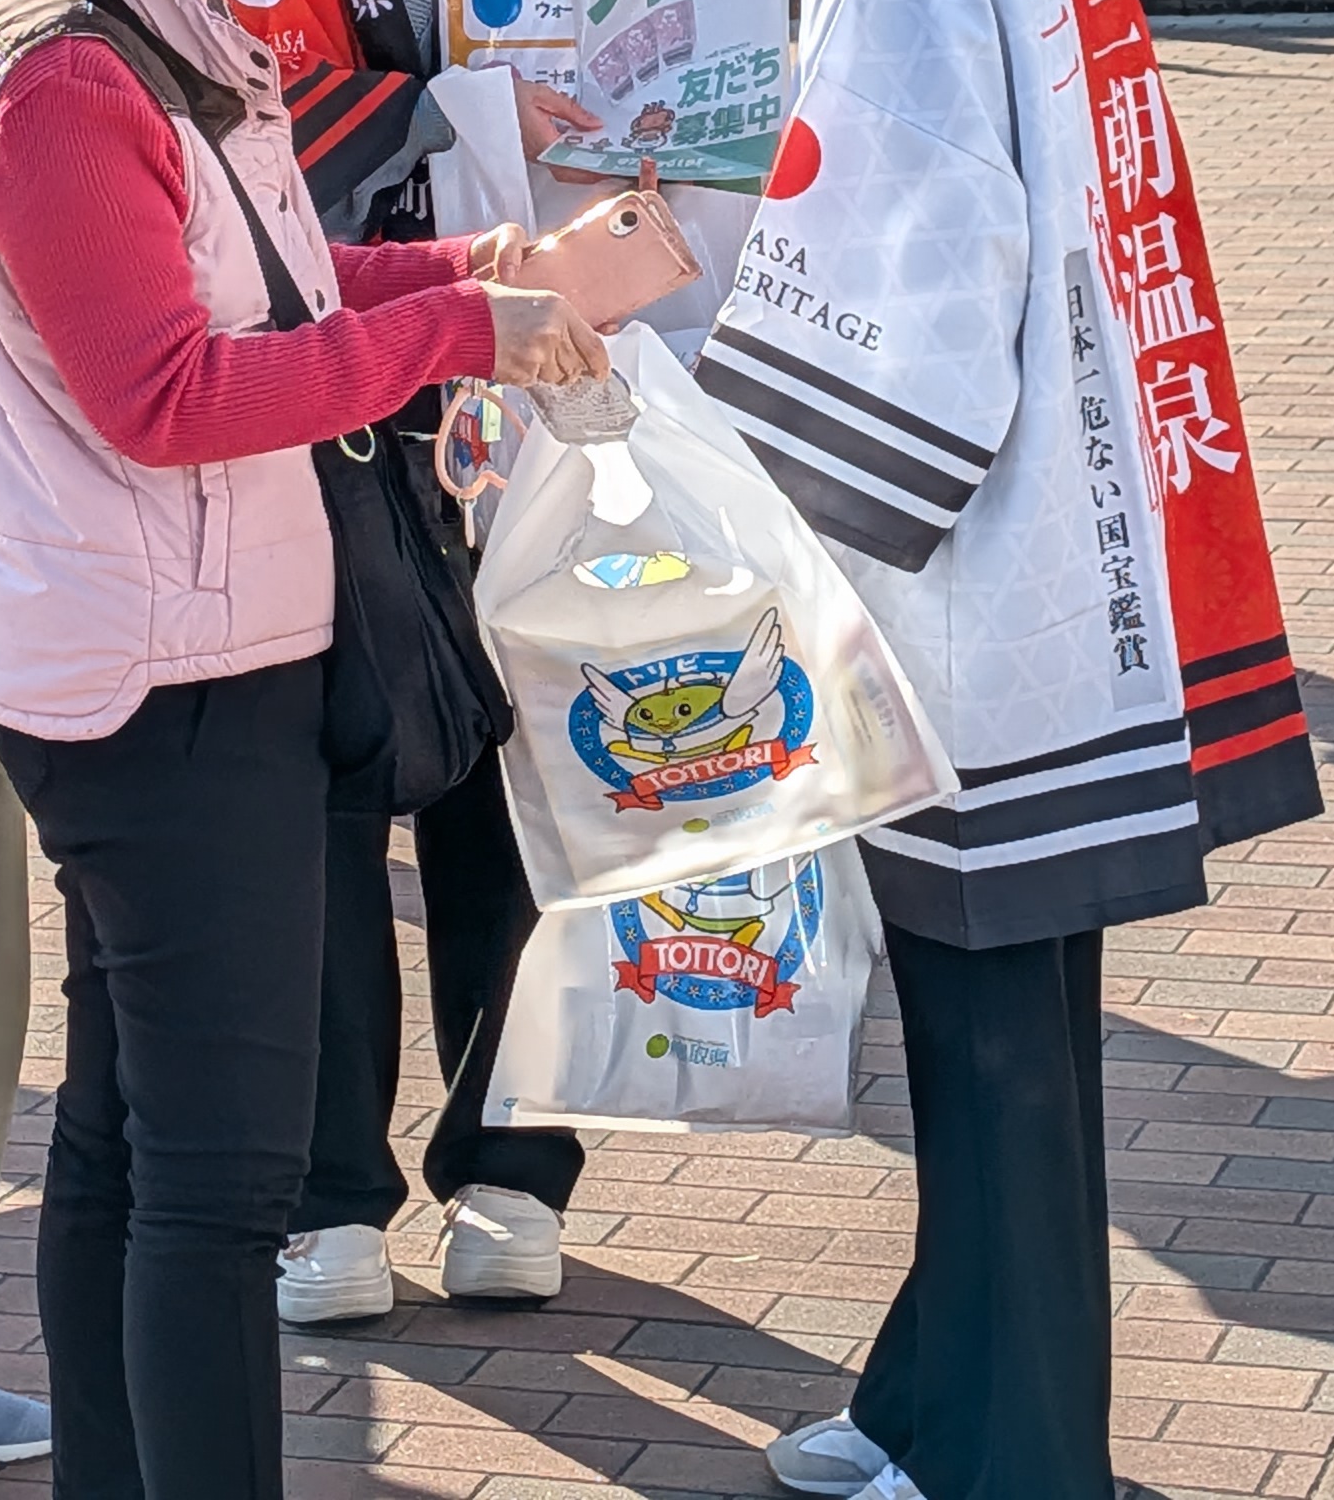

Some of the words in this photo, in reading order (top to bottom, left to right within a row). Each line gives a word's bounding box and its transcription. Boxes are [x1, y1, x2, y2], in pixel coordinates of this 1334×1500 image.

[676, 47, 781, 109] 友だち
[671, 93, 782, 146] 募集中
[642, 742, 775, 790] TOTTORI
[652, 942, 770, 986] TOTTORI
